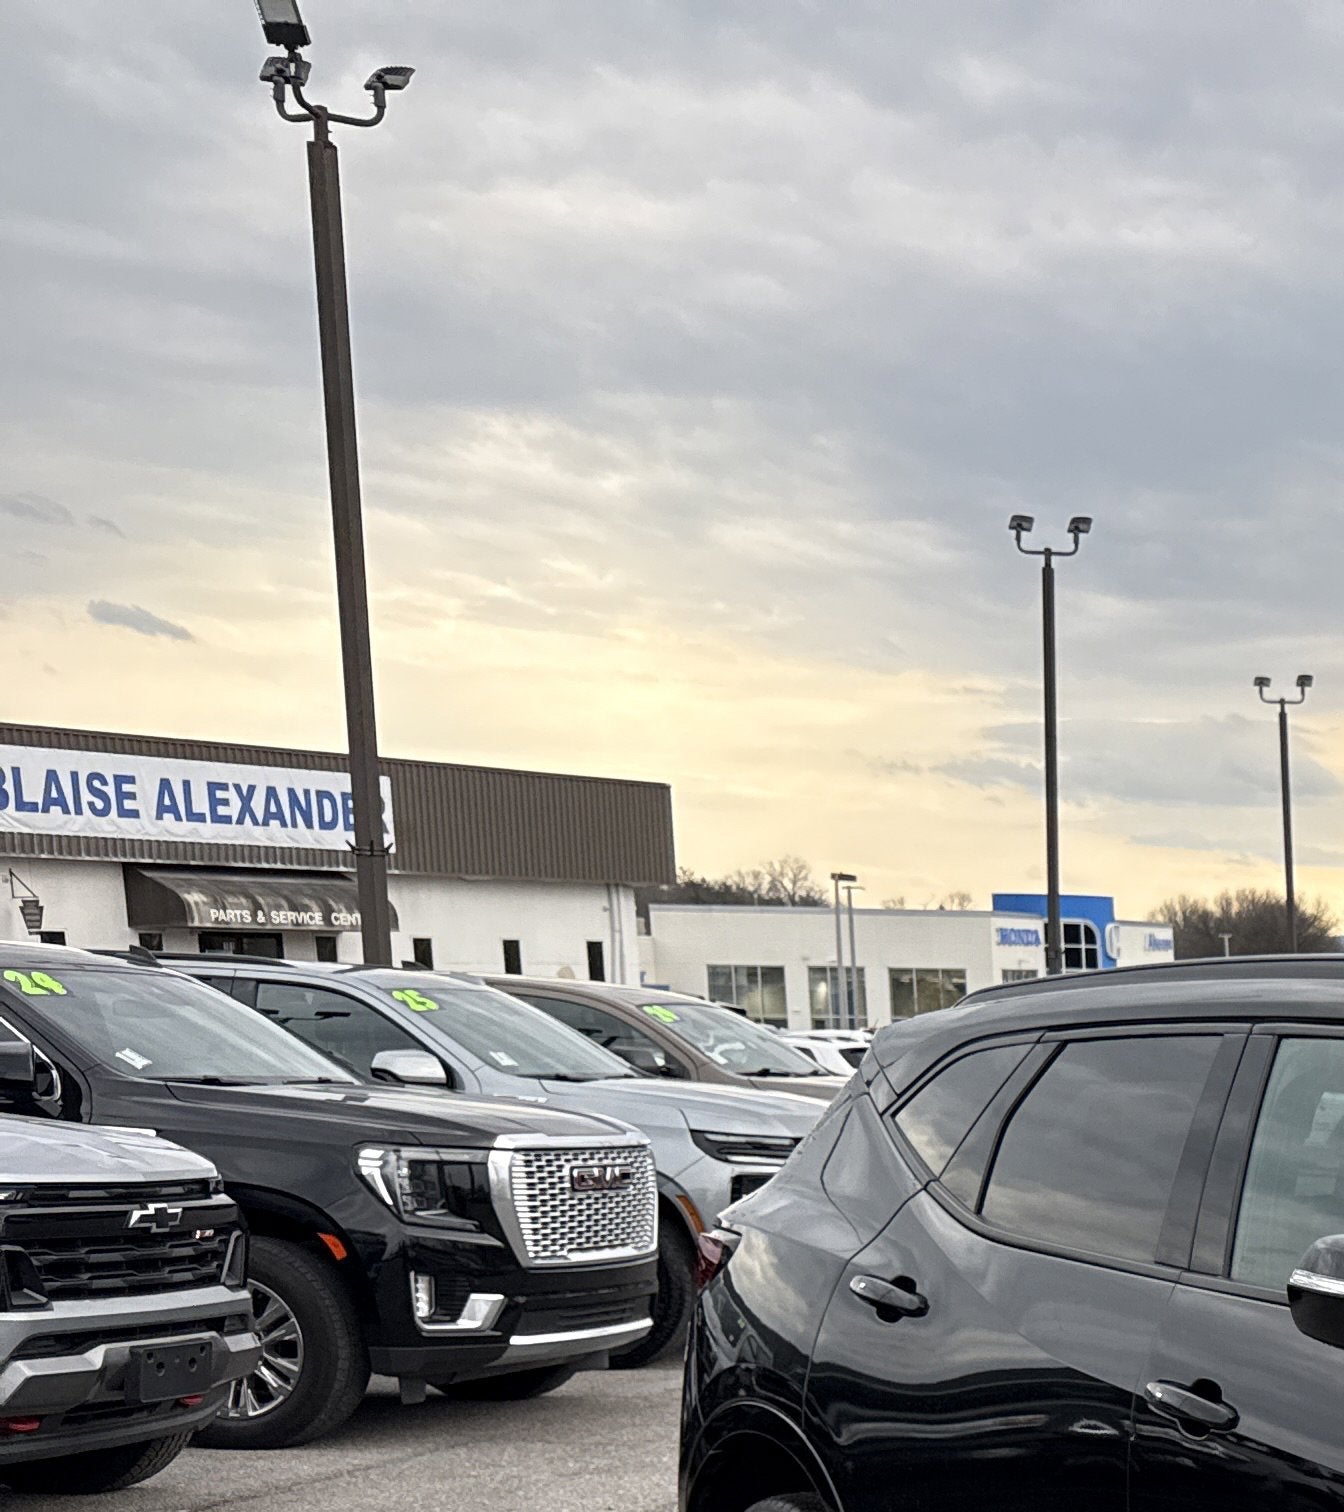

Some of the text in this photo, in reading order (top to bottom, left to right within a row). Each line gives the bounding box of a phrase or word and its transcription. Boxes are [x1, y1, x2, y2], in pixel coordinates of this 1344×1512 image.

[209, 908, 362, 926] PARTS & SERVICE CENT
[571, 1164, 634, 1191] GMC
